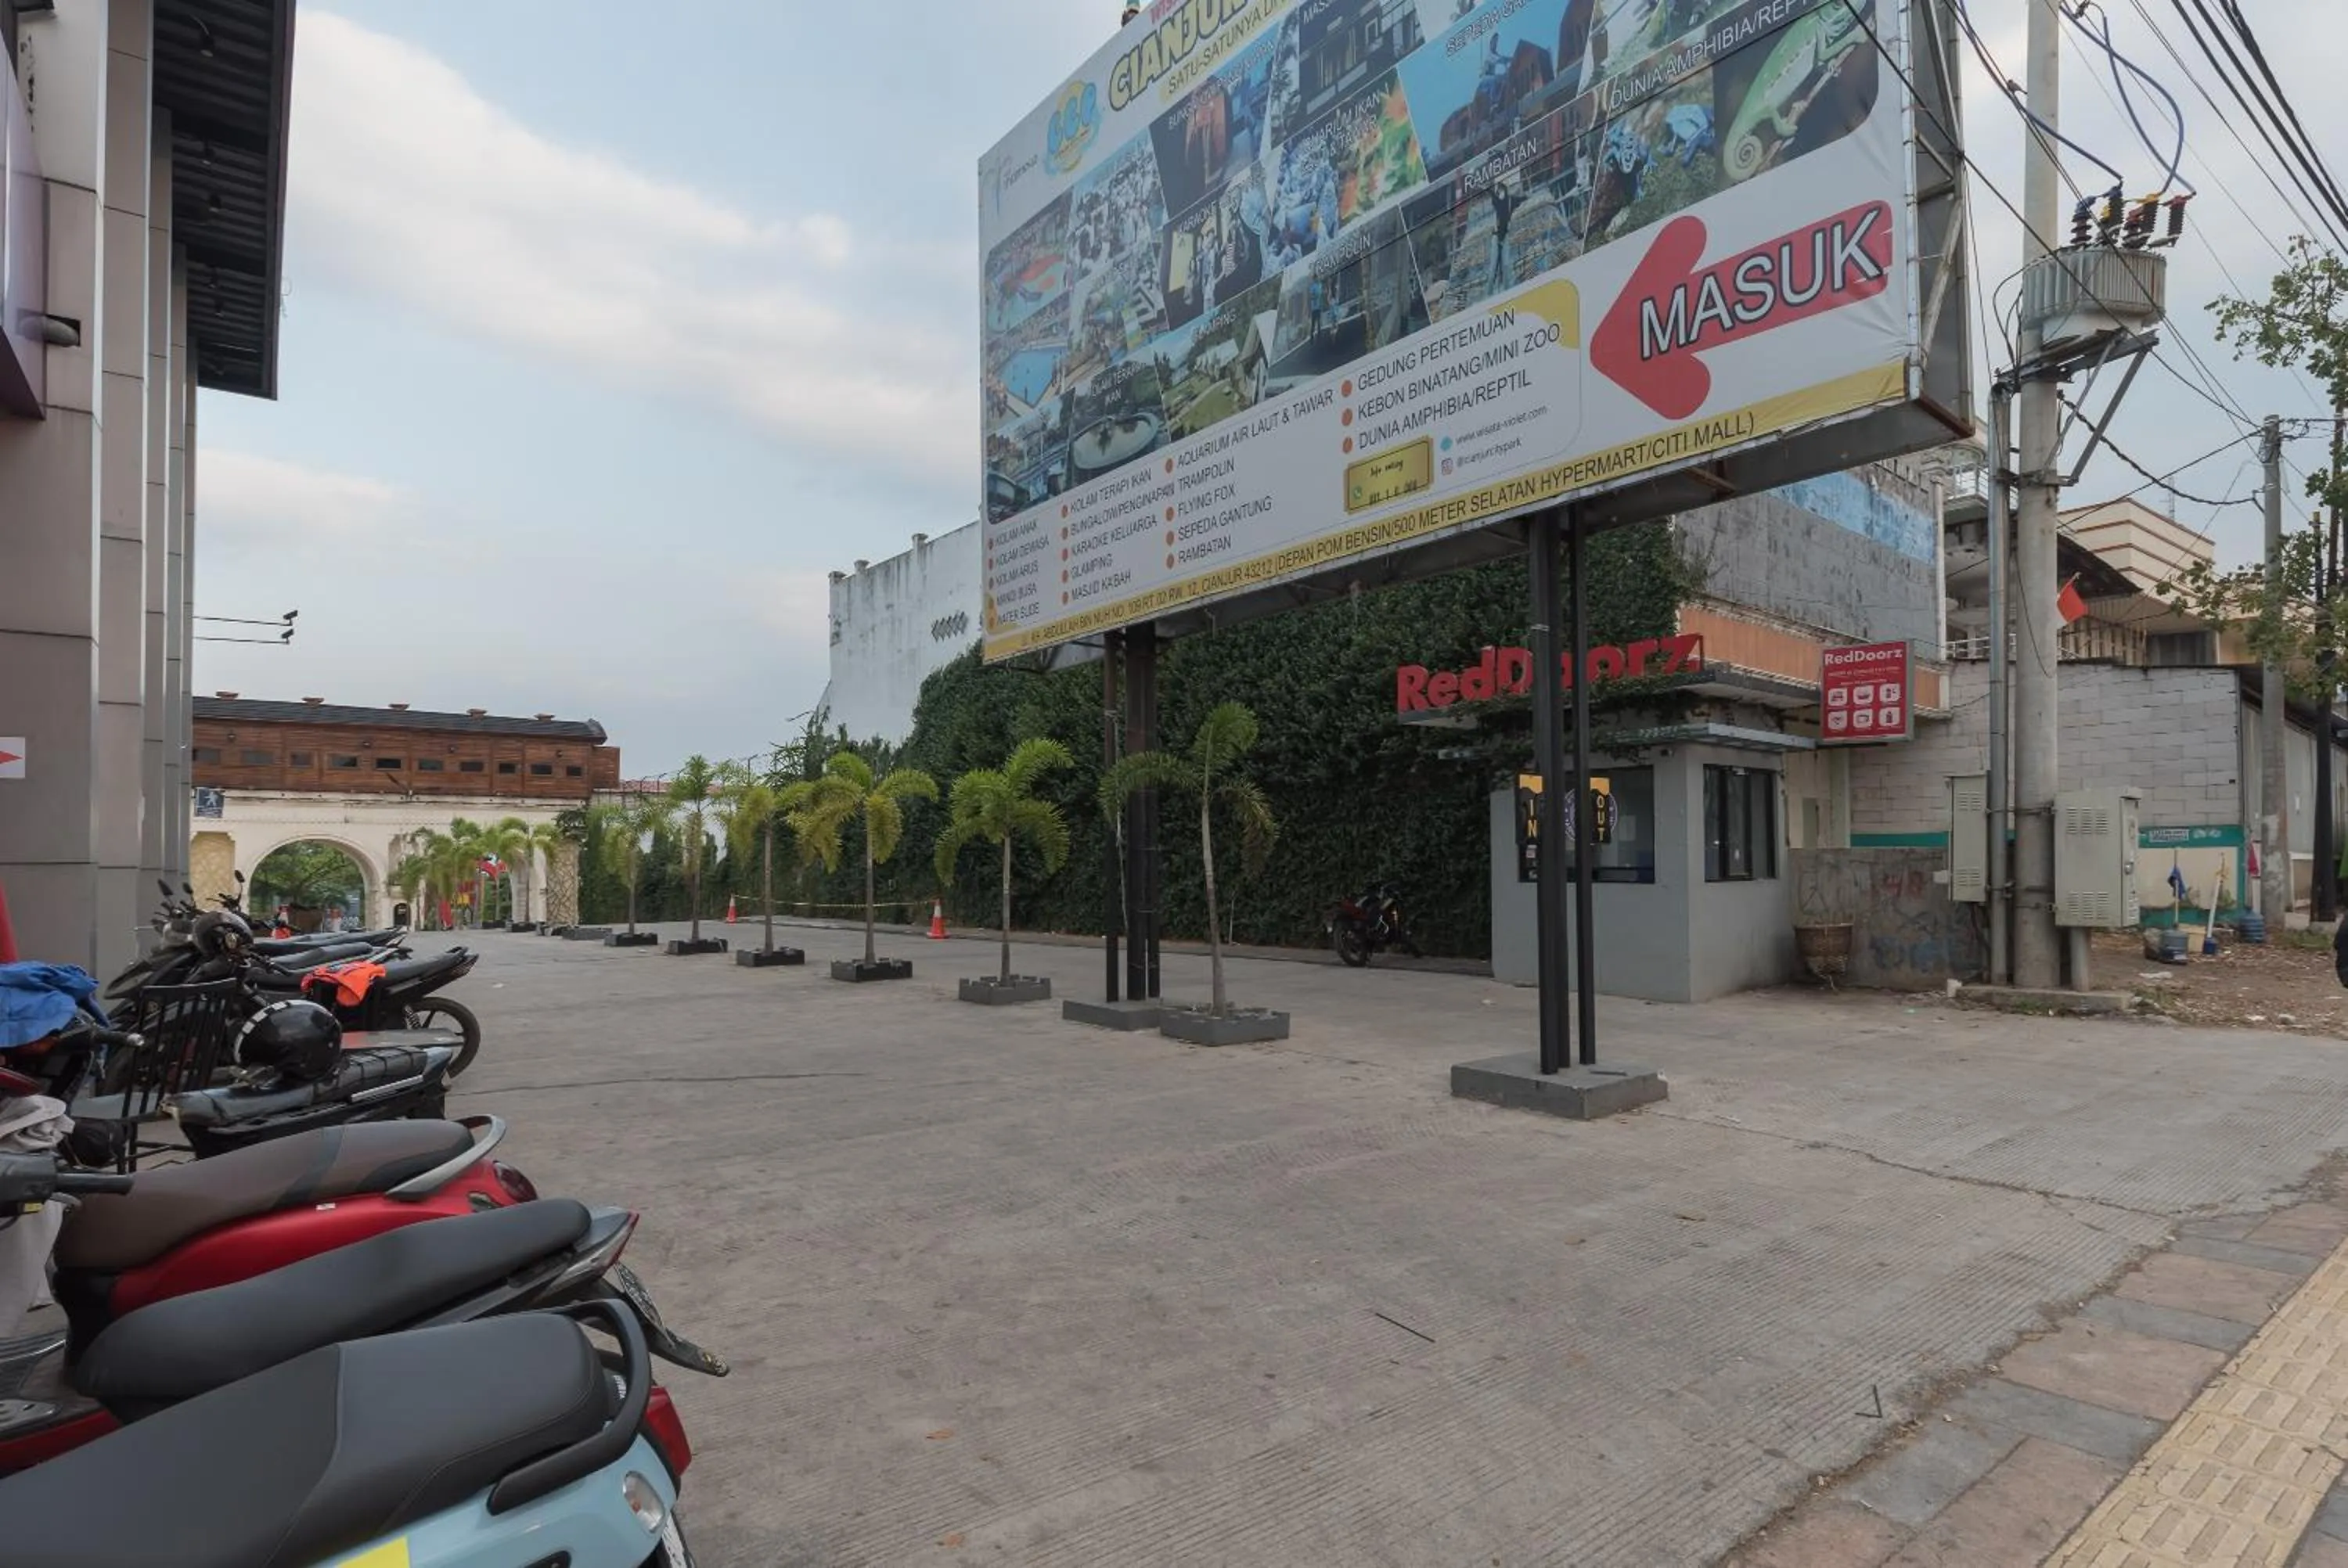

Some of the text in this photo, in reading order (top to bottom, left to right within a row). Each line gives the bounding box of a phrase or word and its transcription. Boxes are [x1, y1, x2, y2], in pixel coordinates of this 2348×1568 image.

[1168, 6, 1262, 94] SATU-SATUNYA
[1610, 0, 1806, 109] DUNIA AMPHIBIA/REP
[1464, 137, 1537, 193] RAMBATAN
[1640, 207, 1884, 361] MASUK
[1357, 307, 1516, 390] GEDUNG PERTEMUAN
[1357, 322, 1561, 421] KEBON BINATANG/MINI ZOO
[1177, 435, 1230, 468] AQUARIUM
[1251, 412, 1280, 437] LAUT
[1281, 408, 1291, 424] &
[1292, 389, 1334, 418] TAWAR
[1358, 368, 1532, 451] DUNIA AMPHIBIA/REPTIL
[1099, 478, 1130, 501] TERAPI
[1177, 456, 1235, 491] TRAMPOLIN
[1177, 483, 1237, 517] FLYING FOX
[1177, 495, 1273, 541] SEPEDA GANTUNG
[1201, 566, 1242, 592] CIANJUR
[1316, 536, 1344, 556] POM
[1345, 512, 1417, 549] BENSIN/500
[1418, 502, 1467, 531] METER
[1470, 477, 1536, 514] SELATAN
[1540, 430, 1688, 497] HYPERMART/CITI
[1693, 412, 1756, 448] MALL)
[1071, 514, 1158, 556] KARAOKE KELUARGA
[1178, 535, 1232, 563] RAMBATAN
[1071, 553, 1113, 580] GLAMPING
[1071, 579, 1100, 601] MASJID
[1397, 633, 1704, 712] RedDorz
[1824, 649, 1903, 666] RedDoorz
[1527, 798, 1538, 839] IN
[1596, 794, 1605, 842] OUT
